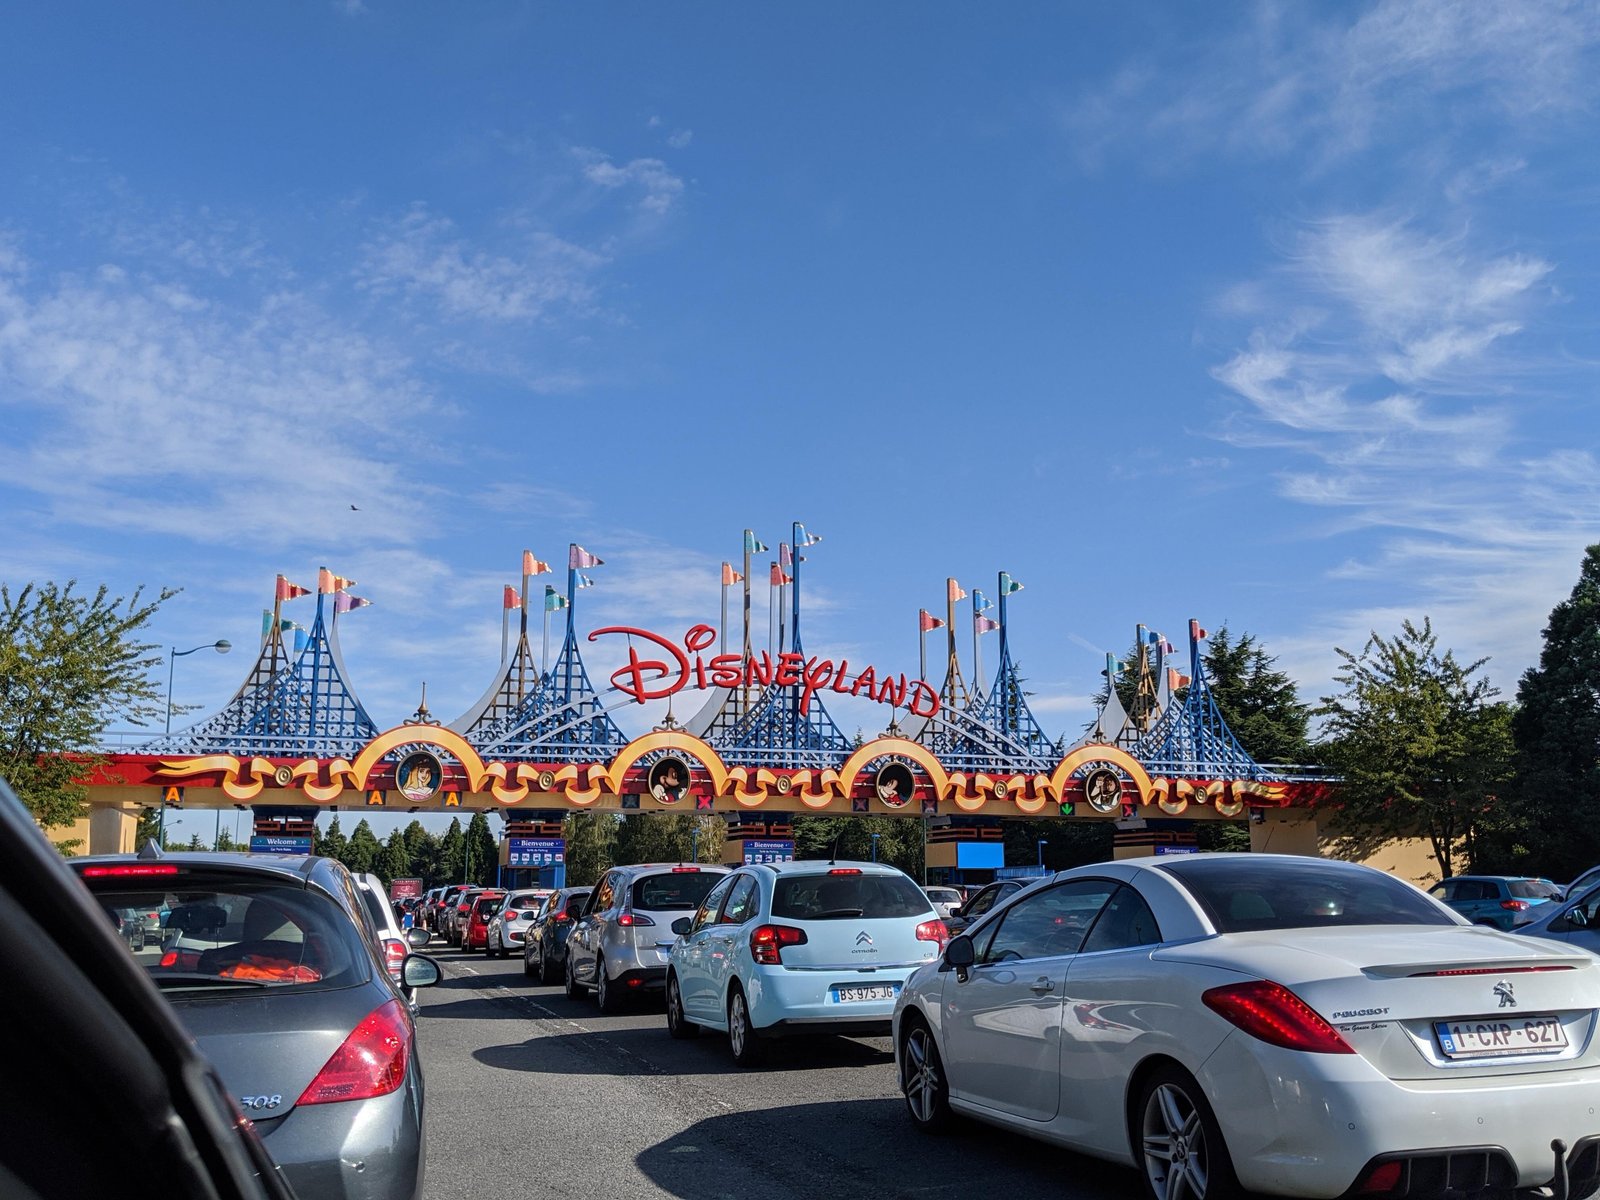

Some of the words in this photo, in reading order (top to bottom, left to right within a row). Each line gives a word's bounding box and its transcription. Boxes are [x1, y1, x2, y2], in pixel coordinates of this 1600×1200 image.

[165, 787, 180, 802] A
[369, 790, 383, 805] A
[446, 792, 460, 807] A
[840, 986, 893, 1001] BS-975-JG
[1332, 1007, 1390, 1019] PEUGEOT
